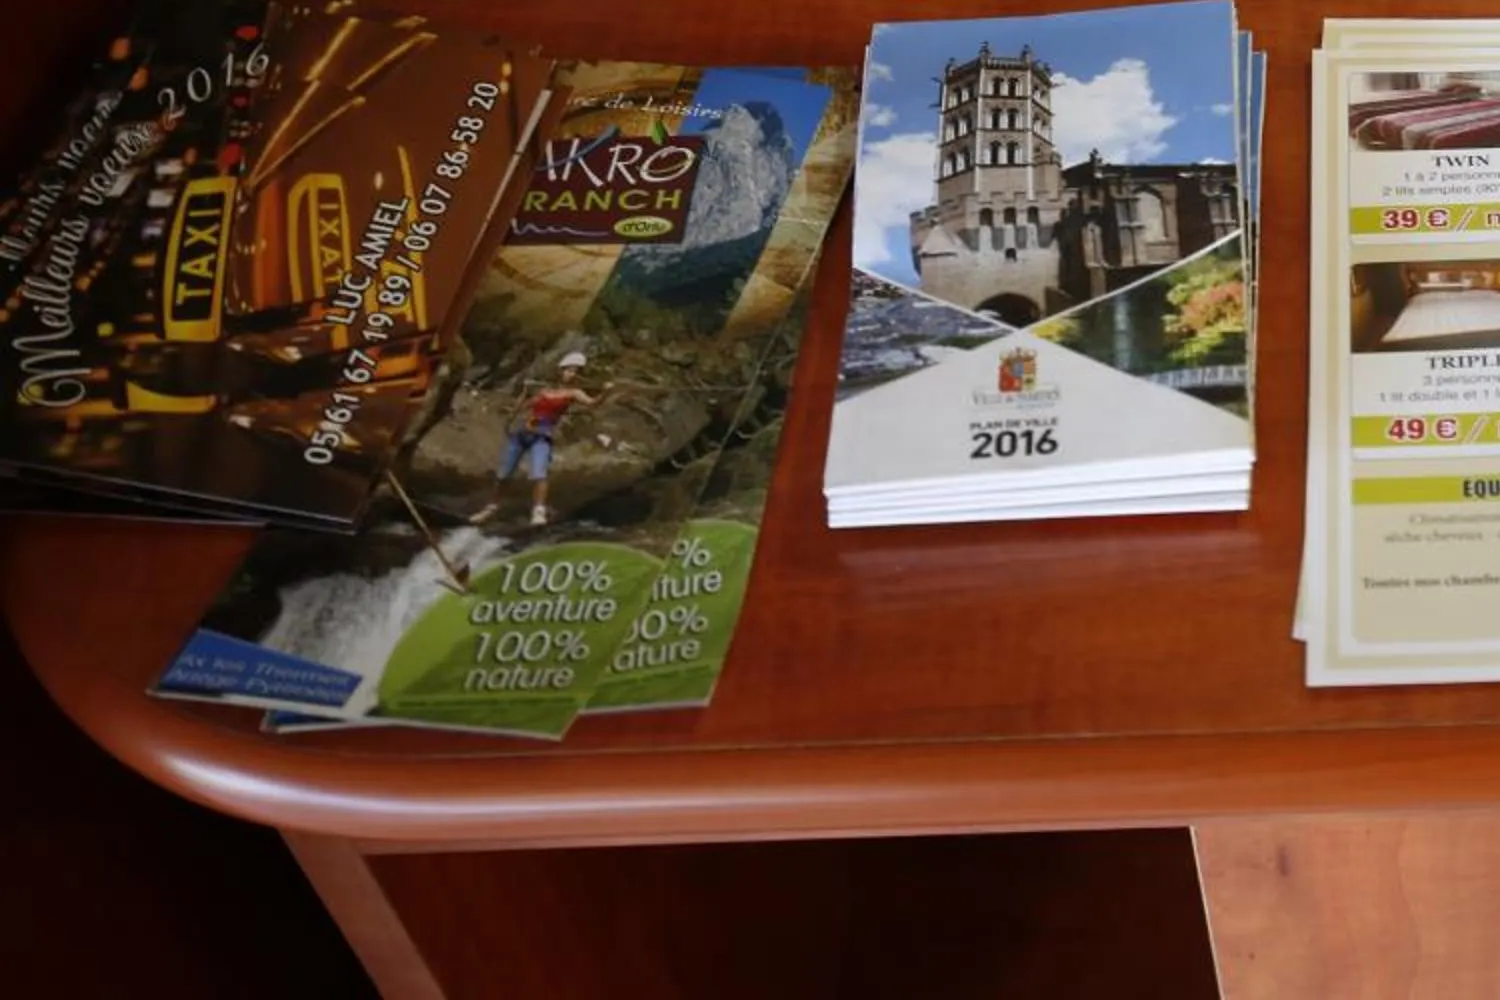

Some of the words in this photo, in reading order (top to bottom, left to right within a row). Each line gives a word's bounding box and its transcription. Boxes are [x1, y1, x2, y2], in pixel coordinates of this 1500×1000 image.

[467, 81, 499, 111] 20
[451, 116, 484, 144] 58
[436, 150, 469, 179] 86
[1432, 154, 1490, 168] TWIN
[420, 183, 451, 215] 07
[523, 189, 684, 212] RANCH
[1383, 209, 1420, 229] 39
[1427, 208, 1450, 228] €
[403, 221, 437, 251] 06
[175, 208, 221, 306] TAXI
[325, 272, 371, 325] LUC
[354, 197, 409, 271] AMIEL
[378, 274, 411, 306] 89
[362, 311, 395, 341] 19
[343, 349, 377, 384] 67
[325, 391, 360, 424] 61
[1408, 390, 1459, 402] double
[969, 428, 1059, 460] 2016
[1387, 418, 1425, 440] 49
[1435, 418, 1457, 439] €
[303, 431, 340, 465] 05
[501, 560, 613, 594] 100%
[471, 594, 617, 624] aventure
[476, 629, 590, 663] 100%
[611, 639, 701, 673] ature
[464, 663, 575, 691] nature
